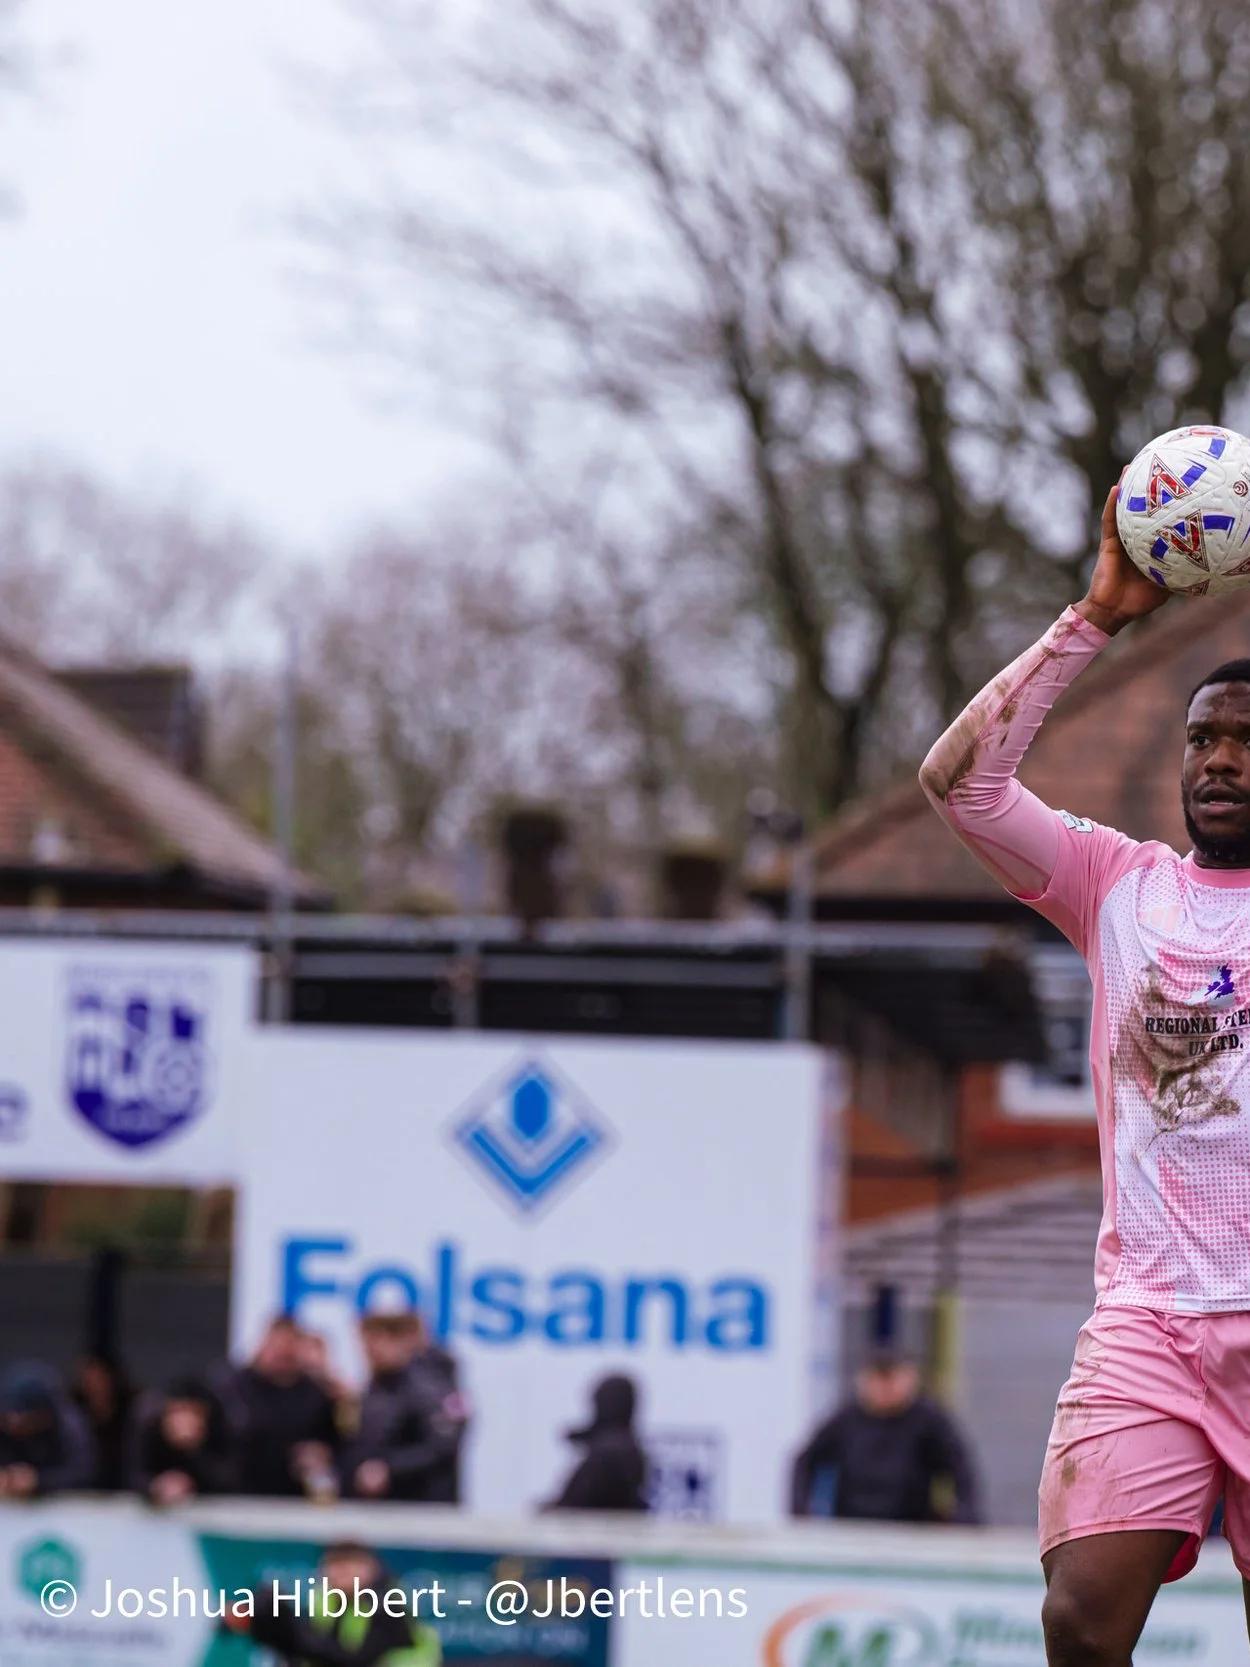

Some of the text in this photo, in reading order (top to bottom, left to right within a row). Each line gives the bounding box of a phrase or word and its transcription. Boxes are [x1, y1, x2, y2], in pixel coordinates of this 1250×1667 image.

[1145, 1016, 1220, 1034] REGIONAL
[1210, 1034, 1243, 1053] LTD.
[279, 1238, 772, 1349] Folsana
